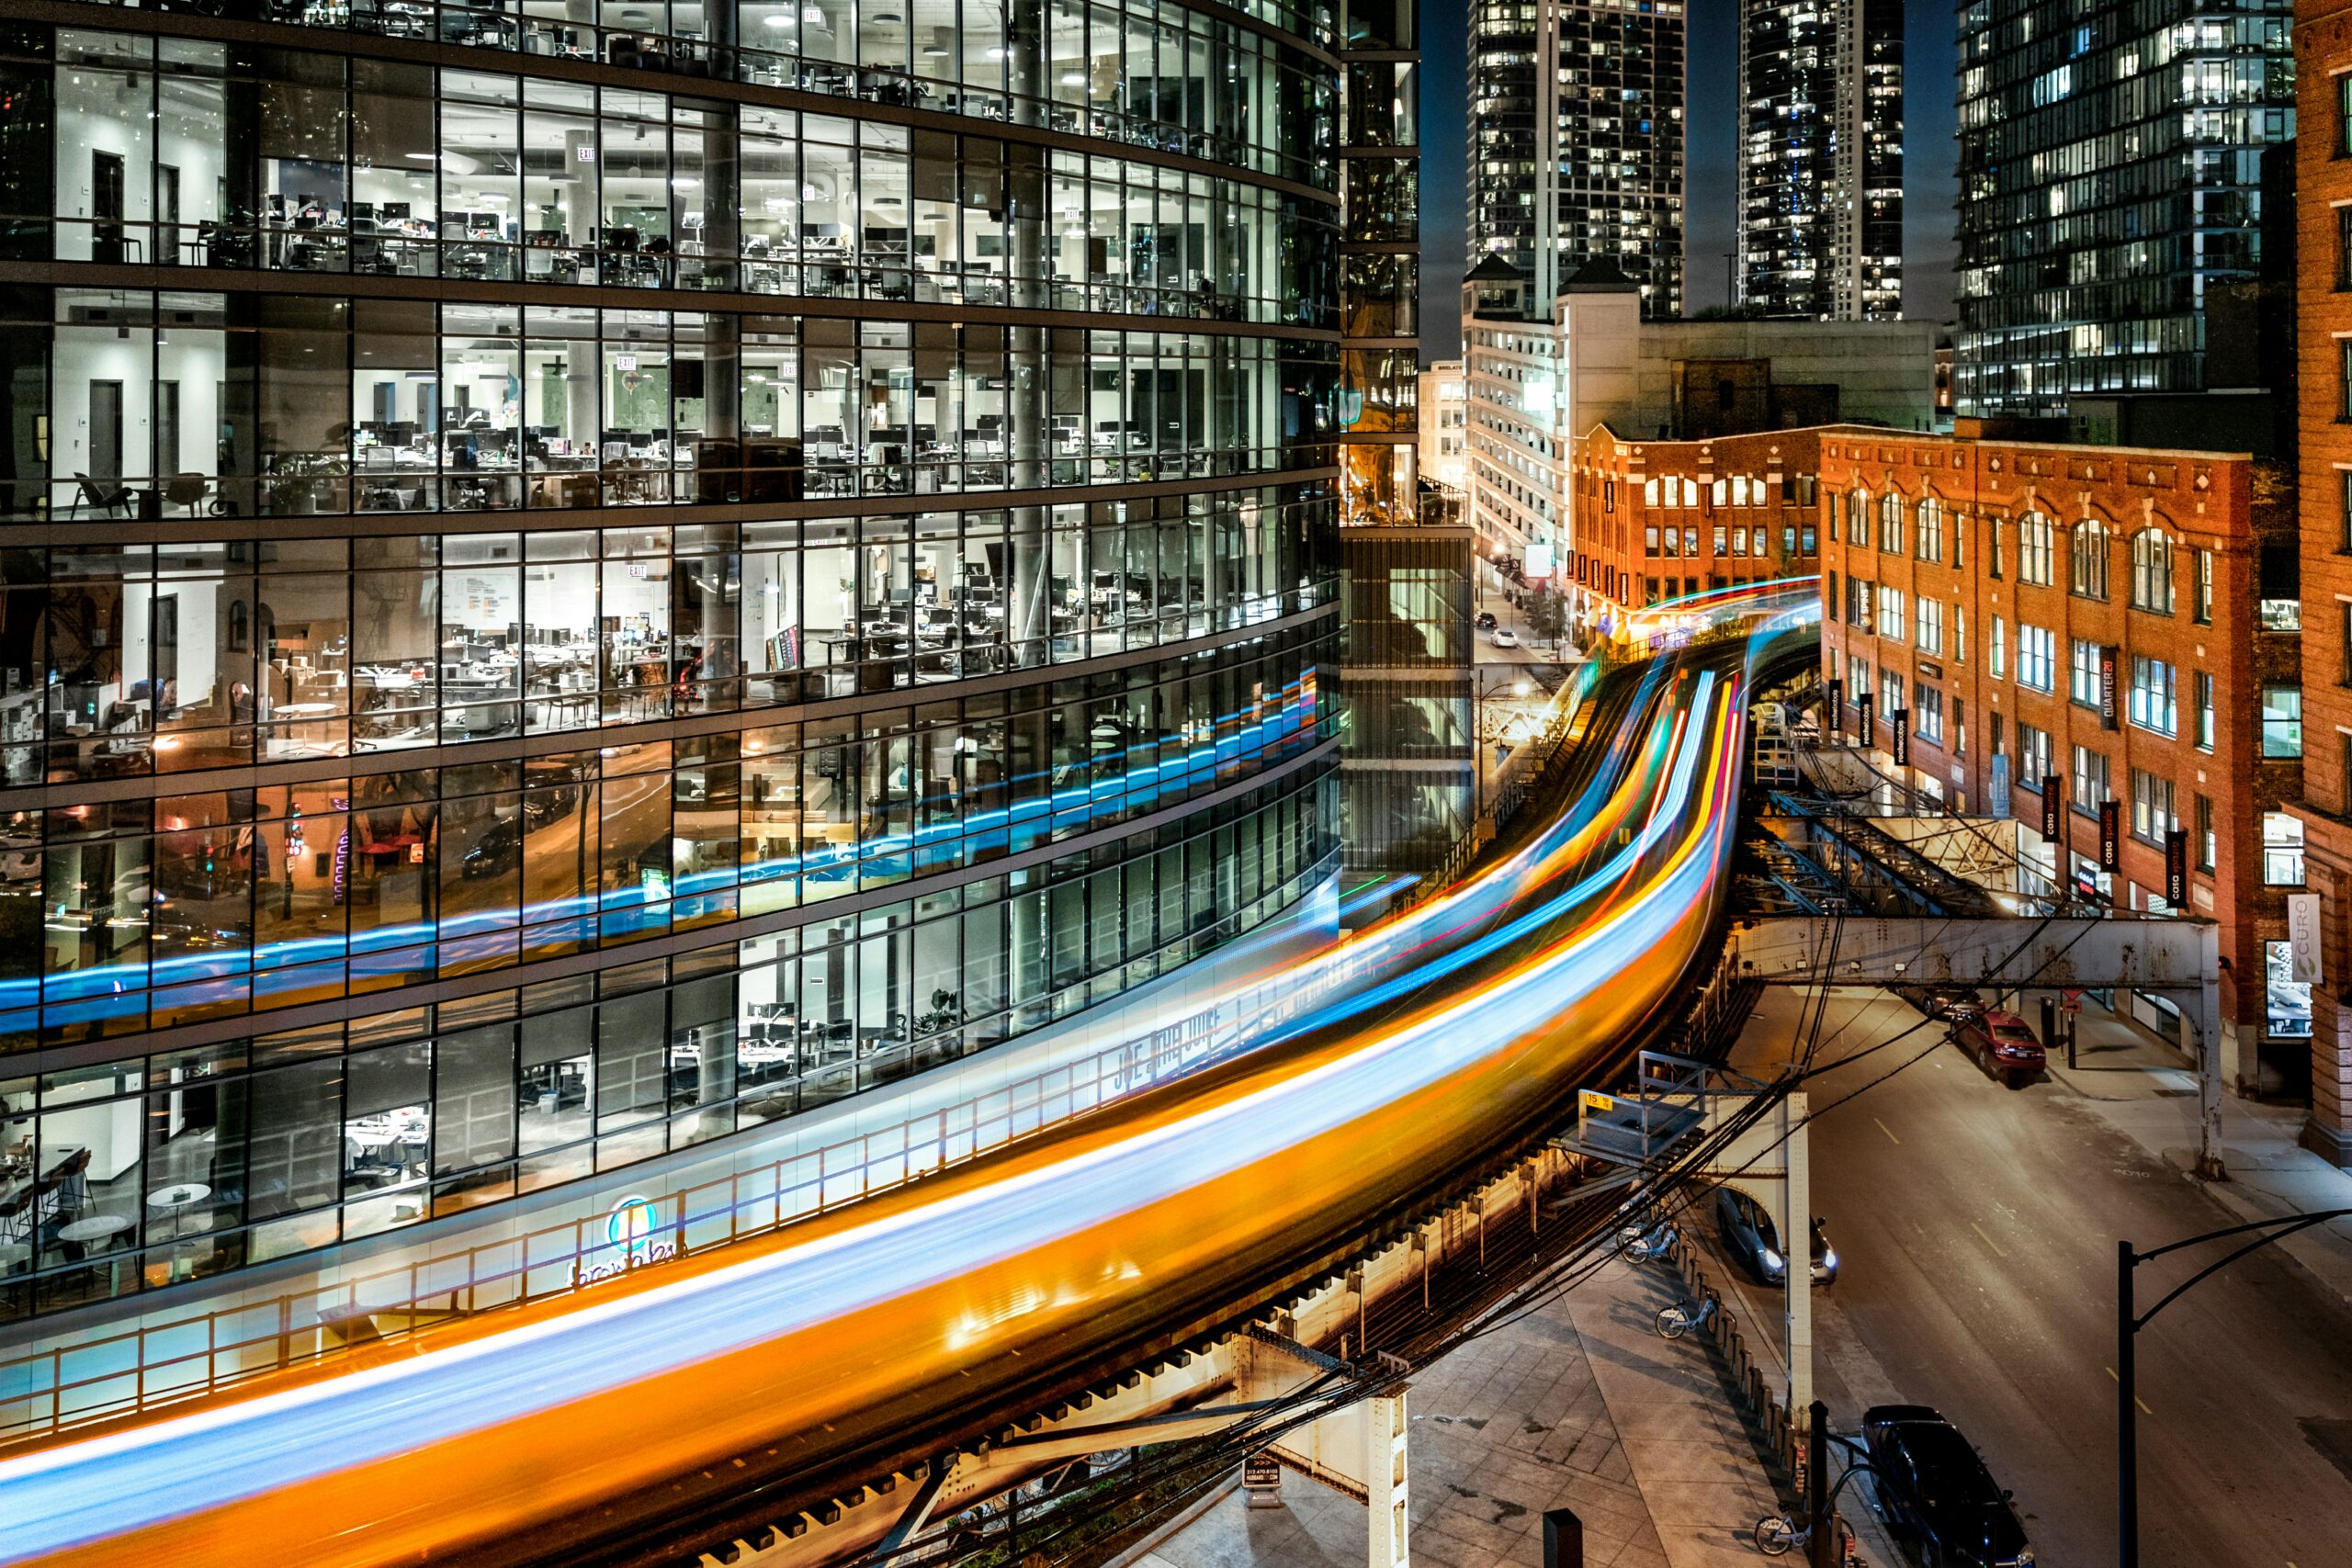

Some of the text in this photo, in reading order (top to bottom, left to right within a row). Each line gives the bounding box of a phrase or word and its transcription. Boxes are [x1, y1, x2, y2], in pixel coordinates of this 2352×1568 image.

[580, 149, 594, 159] EXIT
[619, 357, 634, 367] EXIT
[629, 565, 645, 575] EXIT
[1860, 589, 1869, 615] SPINS
[2103, 660, 2113, 717] QUARTER20
[2172, 875, 2180, 900] casa
[2295, 900, 2309, 955] CURO
[1114, 1043, 1142, 1089] JOE
[1157, 1024, 1181, 1067] THE
[1185, 1002, 1221, 1052] JUICE
[1588, 1093, 1598, 1103] 15
